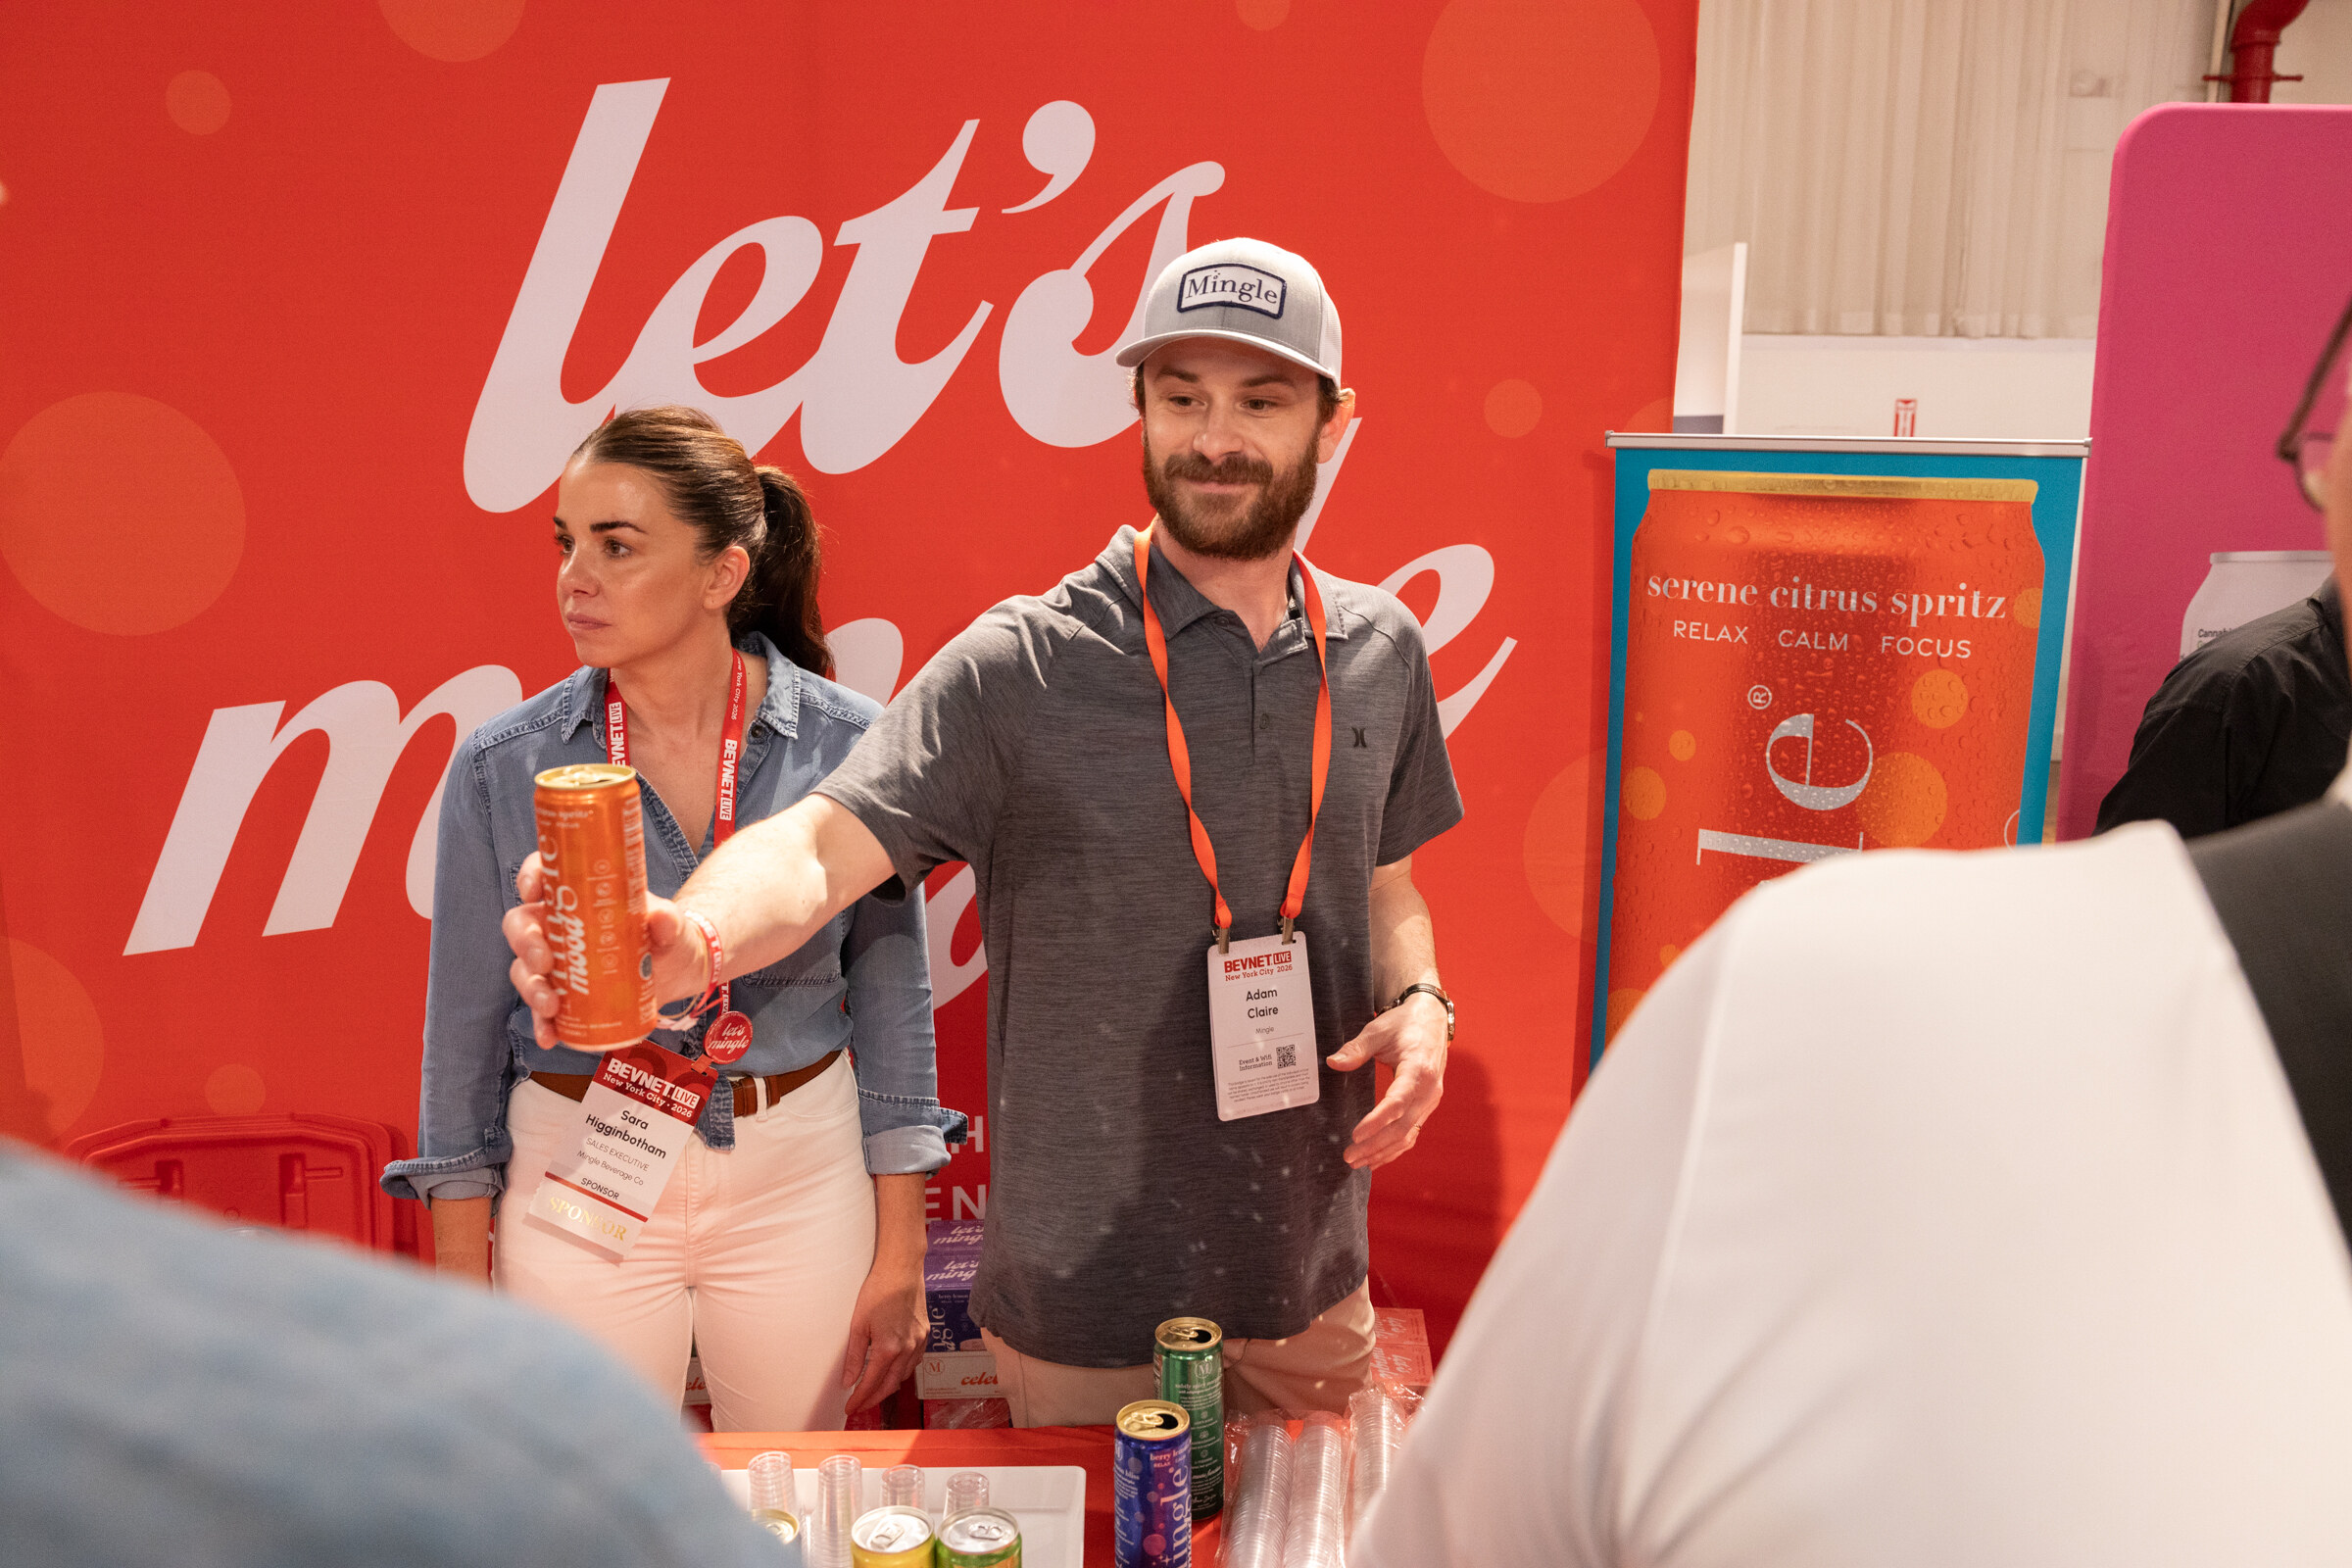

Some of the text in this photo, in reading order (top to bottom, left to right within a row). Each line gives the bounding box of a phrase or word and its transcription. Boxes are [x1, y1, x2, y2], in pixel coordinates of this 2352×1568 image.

[464, 76, 1225, 513] let's
[1185, 270, 1278, 304] Mingle
[1646, 575, 2006, 628] serene citrus spritz
[1673, 620, 1972, 659] RELAX CALM FOCUS
[610, 722, 626, 768] EVNET
[719, 797, 733, 821] LIVE
[1272, 951, 1292, 965] LIVE
[1225, 964, 1293, 982] New York City 2026
[1246, 988, 1278, 1002] Adam
[1247, 1005, 1279, 1019] Claire
[721, 1022, 746, 1037] let's
[1255, 1026, 1274, 1035] Mingle
[708, 1035, 750, 1054] mingle
[1239, 1057, 1254, 1066] Event
[1239, 1060, 1273, 1072] Information
[603, 1073, 693, 1118] New York City 2026
[671, 1085, 701, 1109] LIVE
[620, 1109, 649, 1130] Sara
[585, 1113, 667, 1159] Higginbotham
[585, 1137, 651, 1172] SALES EXECUTIVE
[576, 1150, 644, 1186] Mingle Beverage Co
[580, 1177, 620, 1200] SPONSOR
[549, 1196, 628, 1242] SPONSOR
[933, 1234, 983, 1246] ming
[925, 1269, 976, 1282] ming
[943, 1260, 979, 1271] let's
[929, 1361, 941, 1372] M
[1150, 1452, 1171, 1461] berry
